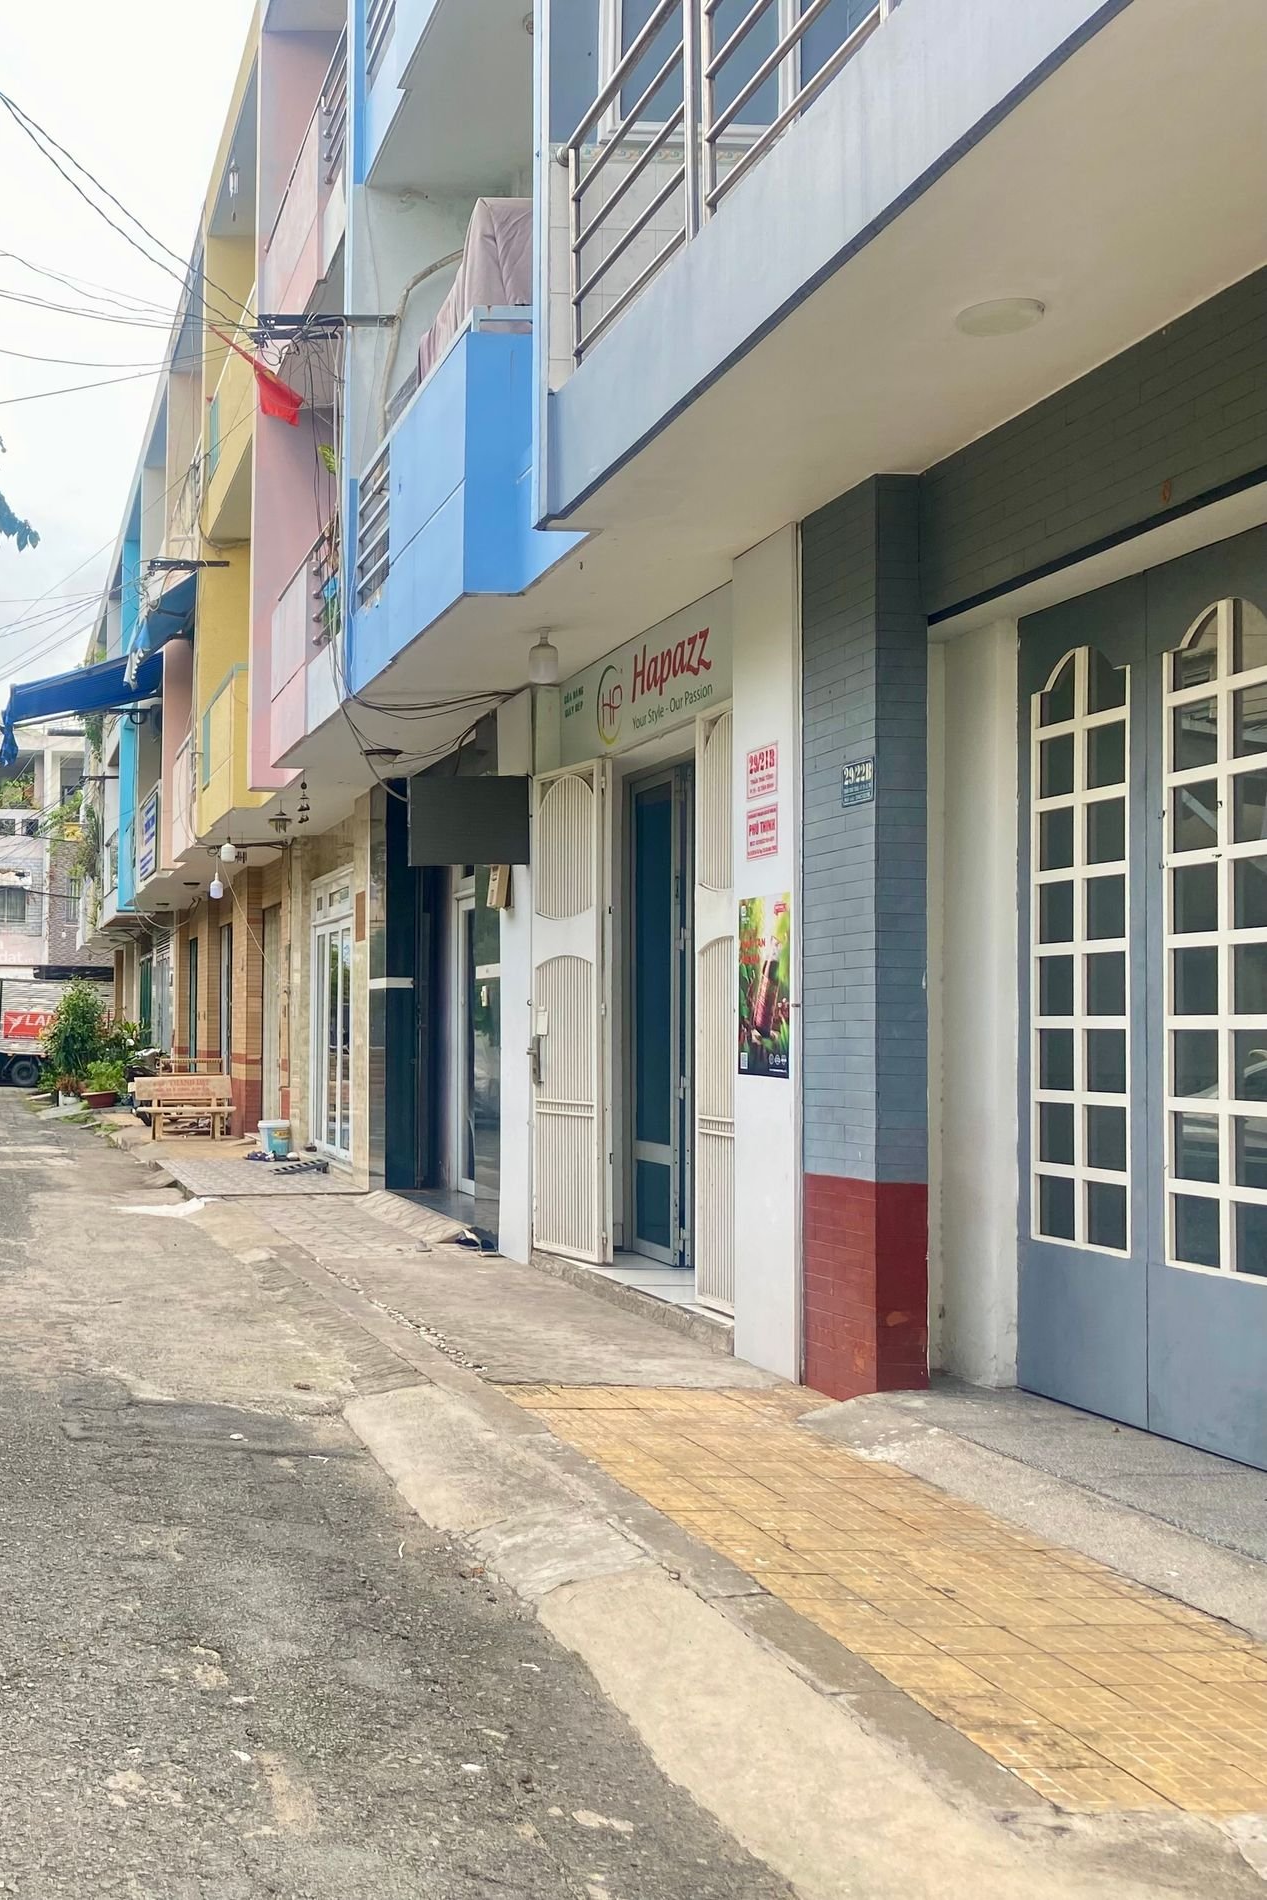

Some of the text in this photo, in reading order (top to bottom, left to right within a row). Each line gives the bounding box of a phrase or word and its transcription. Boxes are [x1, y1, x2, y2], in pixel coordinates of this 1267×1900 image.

[631, 627, 712, 703] Hapazz
[632, 713, 648, 729] Your
[648, 704, 665, 725] Style
[669, 697, 684, 713] Our
[684, 684, 713, 706] Passion
[749, 748, 775, 774] 29/21B
